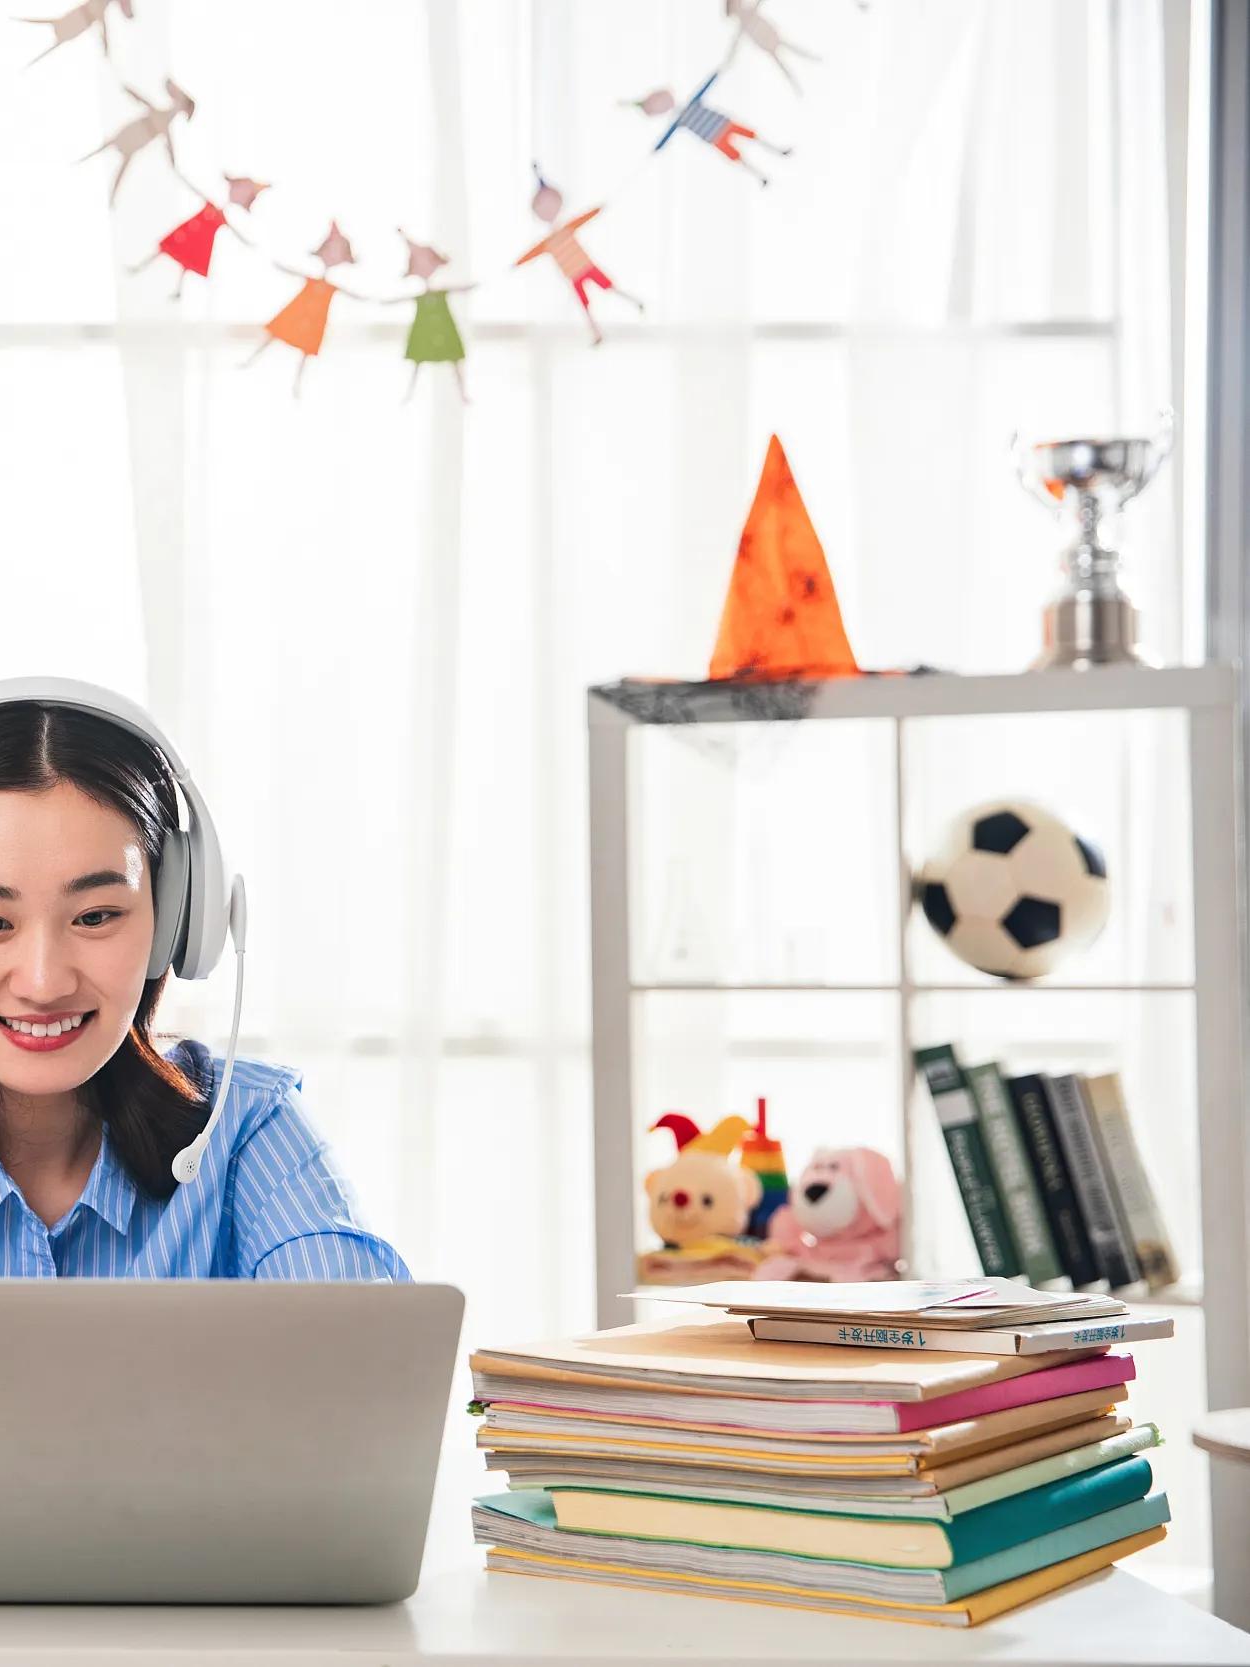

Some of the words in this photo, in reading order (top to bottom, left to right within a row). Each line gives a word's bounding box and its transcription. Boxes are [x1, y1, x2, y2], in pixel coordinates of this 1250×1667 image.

[838, 1325, 926, 1347] 1岁全脑开发卡
